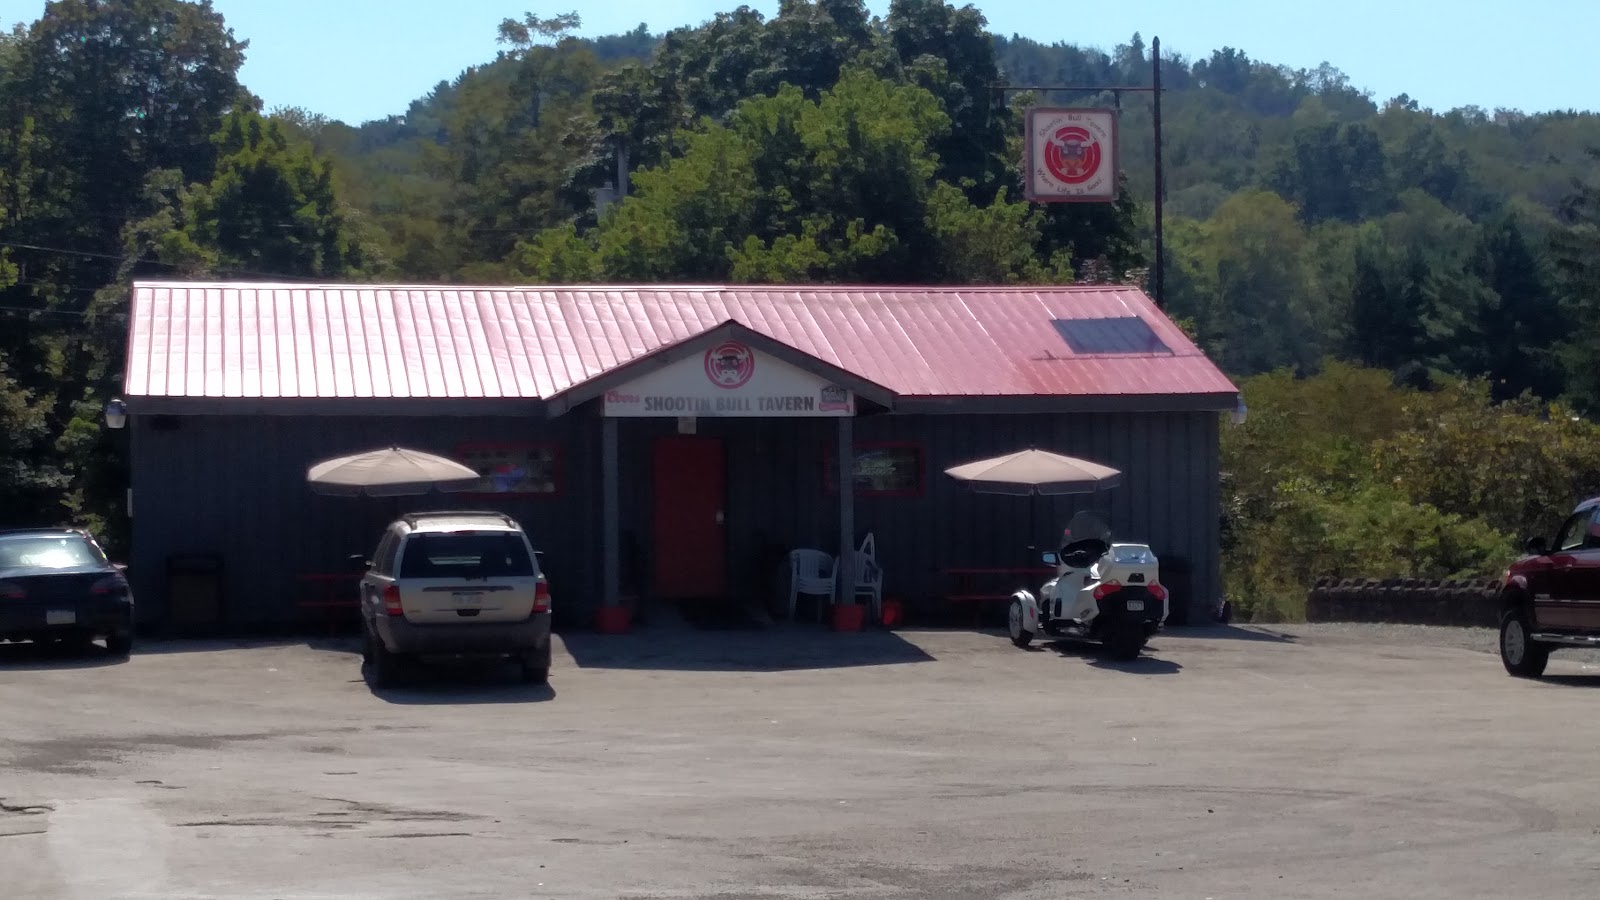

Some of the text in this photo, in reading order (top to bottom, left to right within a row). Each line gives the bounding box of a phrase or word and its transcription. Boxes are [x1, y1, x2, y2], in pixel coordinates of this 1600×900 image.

[644, 396, 711, 411] SHOOTIN
[716, 396, 750, 411] BULL
[757, 396, 814, 411] TAVERN
